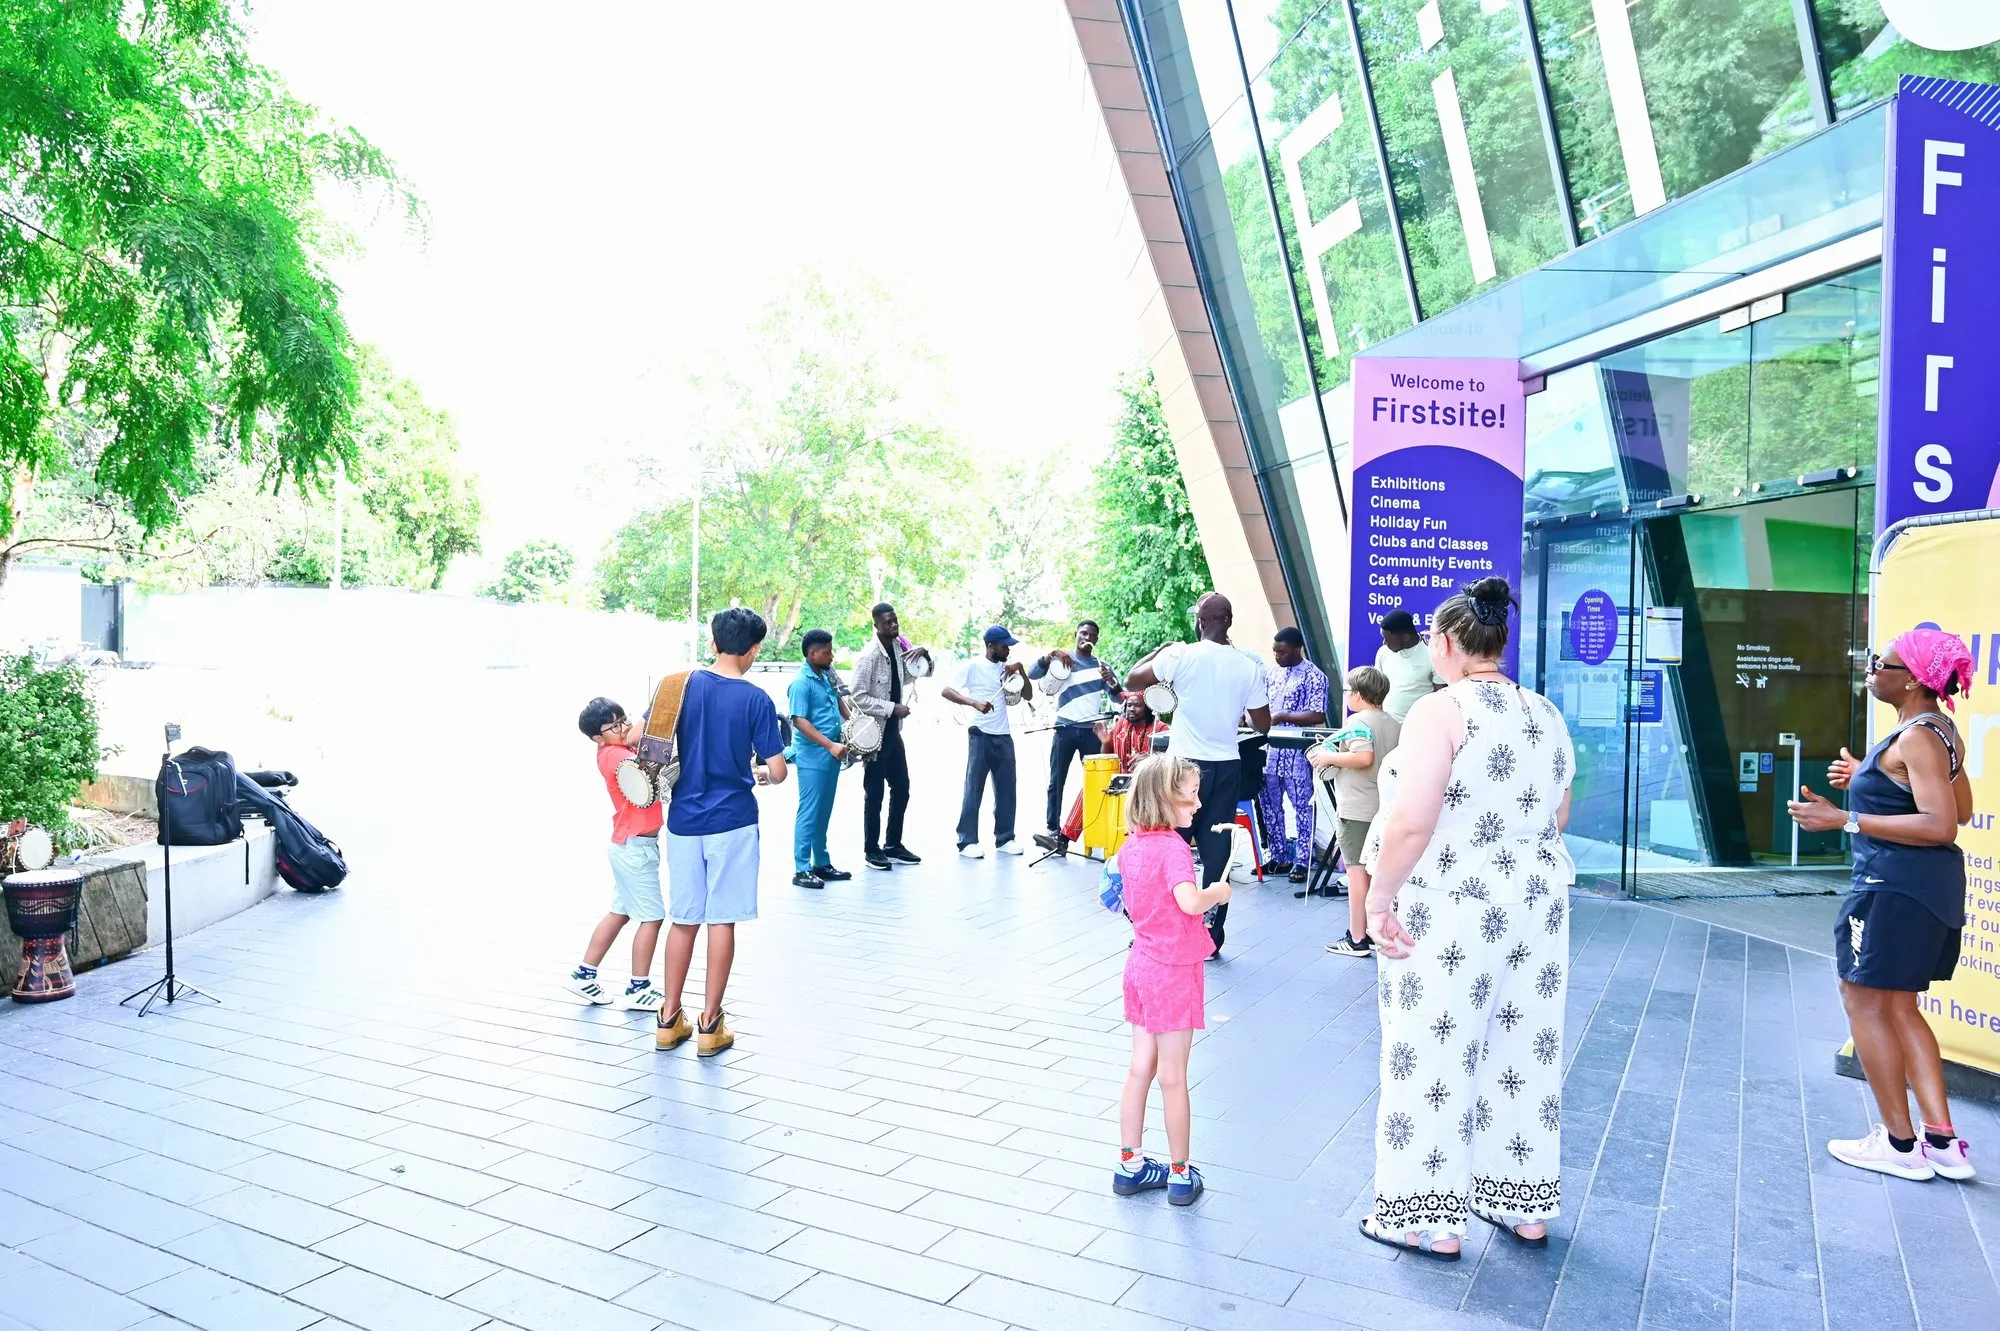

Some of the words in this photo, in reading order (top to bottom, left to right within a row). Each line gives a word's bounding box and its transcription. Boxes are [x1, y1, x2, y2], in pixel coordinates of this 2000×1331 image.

[1391, 373, 1464, 391] Welcome
[1469, 378, 1485, 392] to
[1373, 397, 1505, 428] Firstsite!
[1371, 476, 1446, 491] Exhibitions
[1370, 495, 1420, 509] Cinema
[1370, 515, 1420, 531] Holiday
[1423, 517, 1447, 529] Fun
[1369, 534, 1407, 548] Clubs
[1410, 537, 1435, 548] and
[1438, 537, 1489, 551] Classes
[1369, 554, 1445, 571] Community
[1448, 557, 1493, 570] Events
[1368, 573, 1399, 586] Café
[1403, 576, 1427, 587] and
[1431, 576, 1454, 588] Bar
[1368, 593, 1402, 608] Shop
[1412, 613, 1420, 625] &
[1959, 812, 1995, 830] ur
[1962, 852, 1992, 870] ted
[1848, 915, 1864, 953] NIKE
[1981, 937, 1993, 953] in
[1951, 999, 2000, 1033] here
